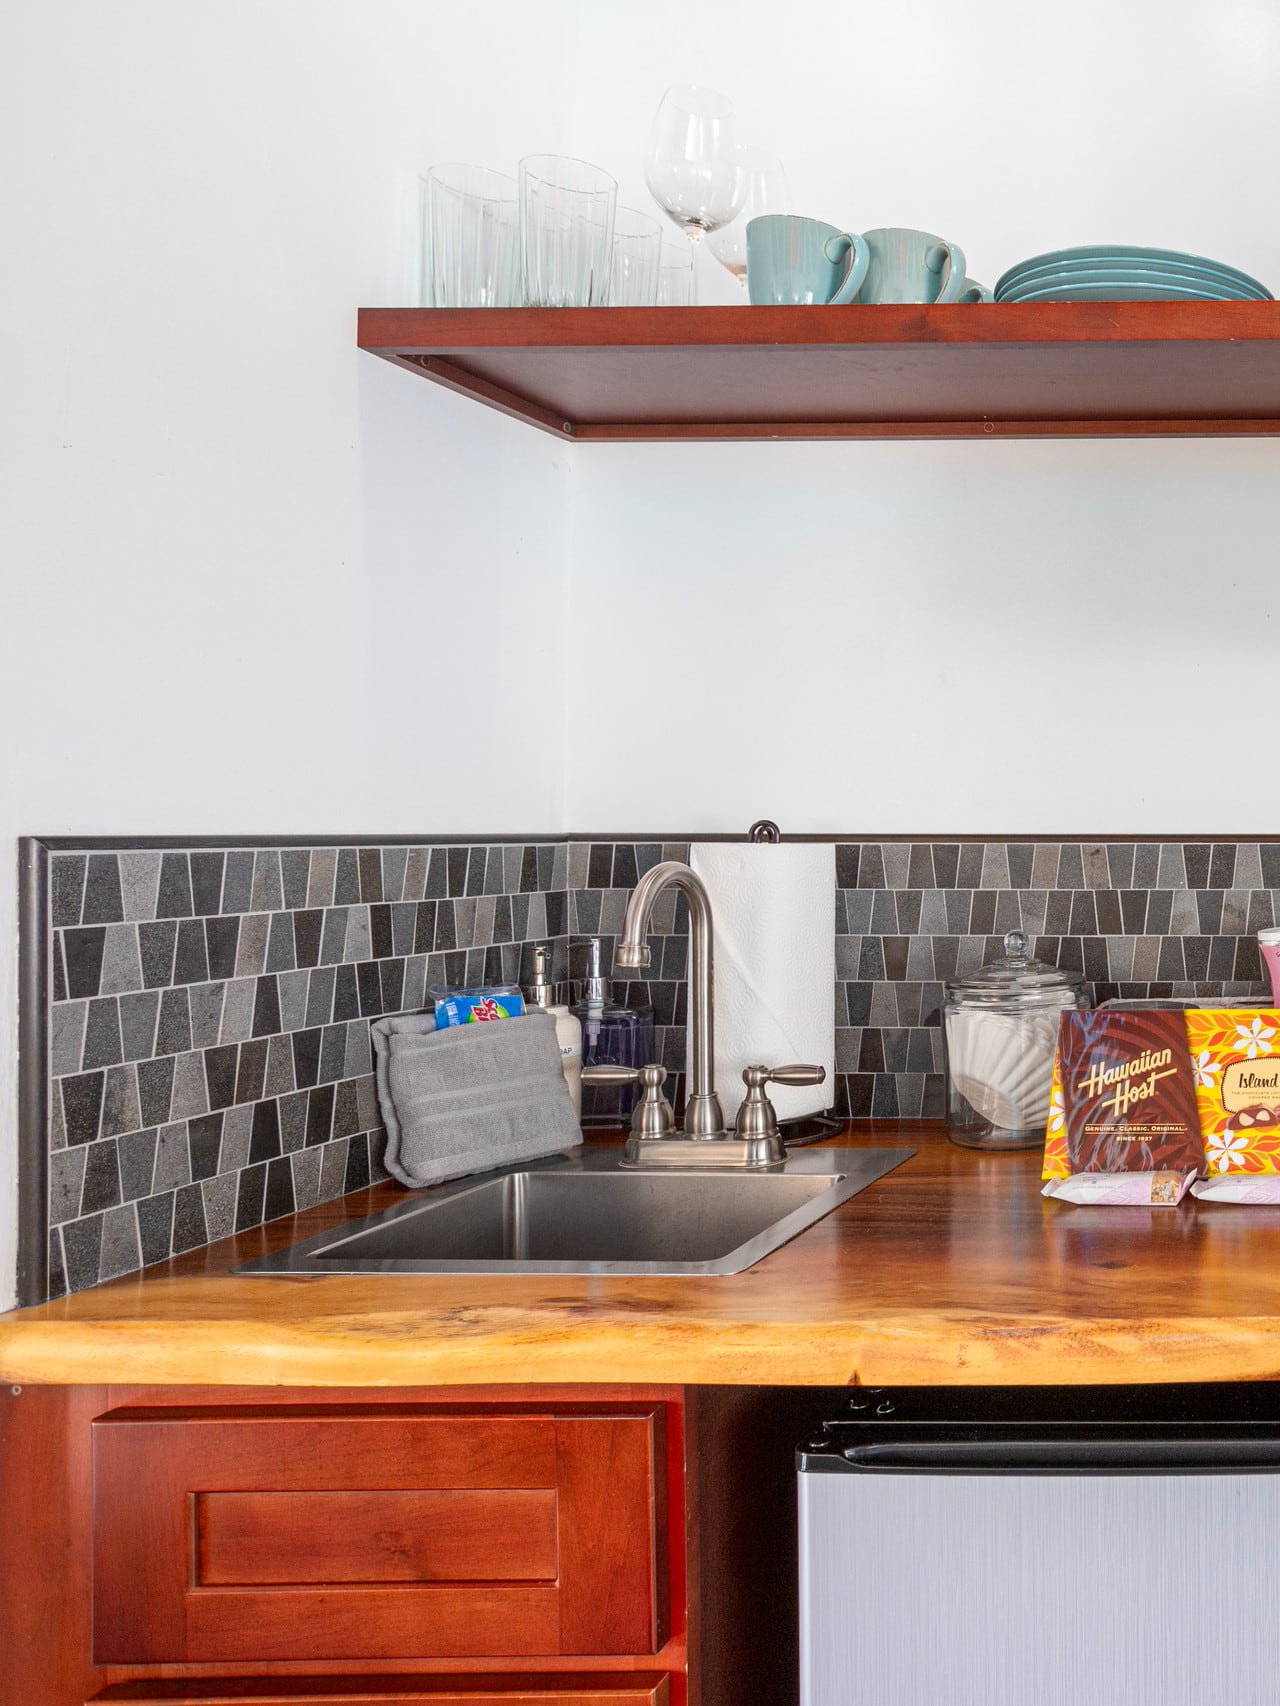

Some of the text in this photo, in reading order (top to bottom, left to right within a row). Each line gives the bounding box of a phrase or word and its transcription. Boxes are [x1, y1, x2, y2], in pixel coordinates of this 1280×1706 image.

[1078, 1048, 1172, 1098] Hawaiian
[1101, 1068, 1178, 1117] Host
[1238, 1072, 1279, 1089] Island
